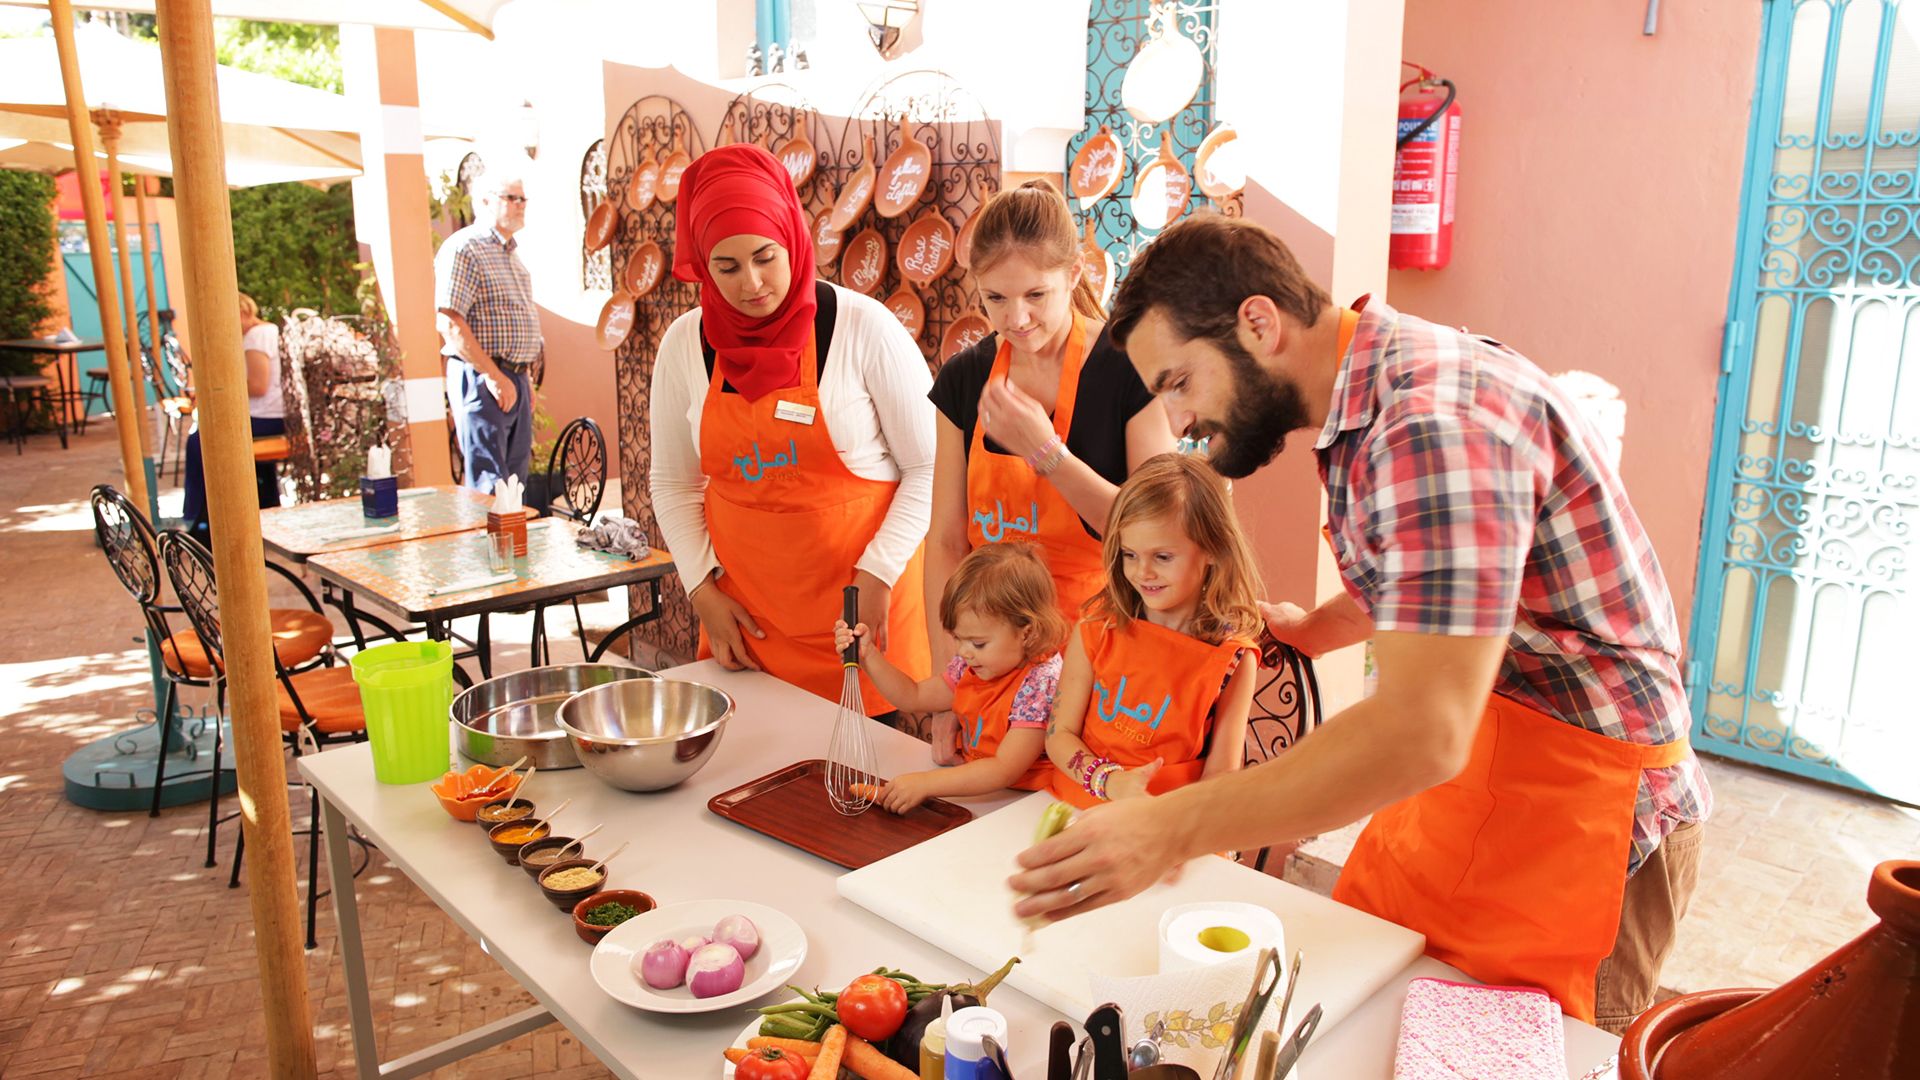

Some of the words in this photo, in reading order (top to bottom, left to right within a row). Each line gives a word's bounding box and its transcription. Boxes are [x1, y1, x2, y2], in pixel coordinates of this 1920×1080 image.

[1398, 121, 1439, 131] POUE
[904, 235, 927, 271] Rose
[1114, 721, 1155, 746] amal
